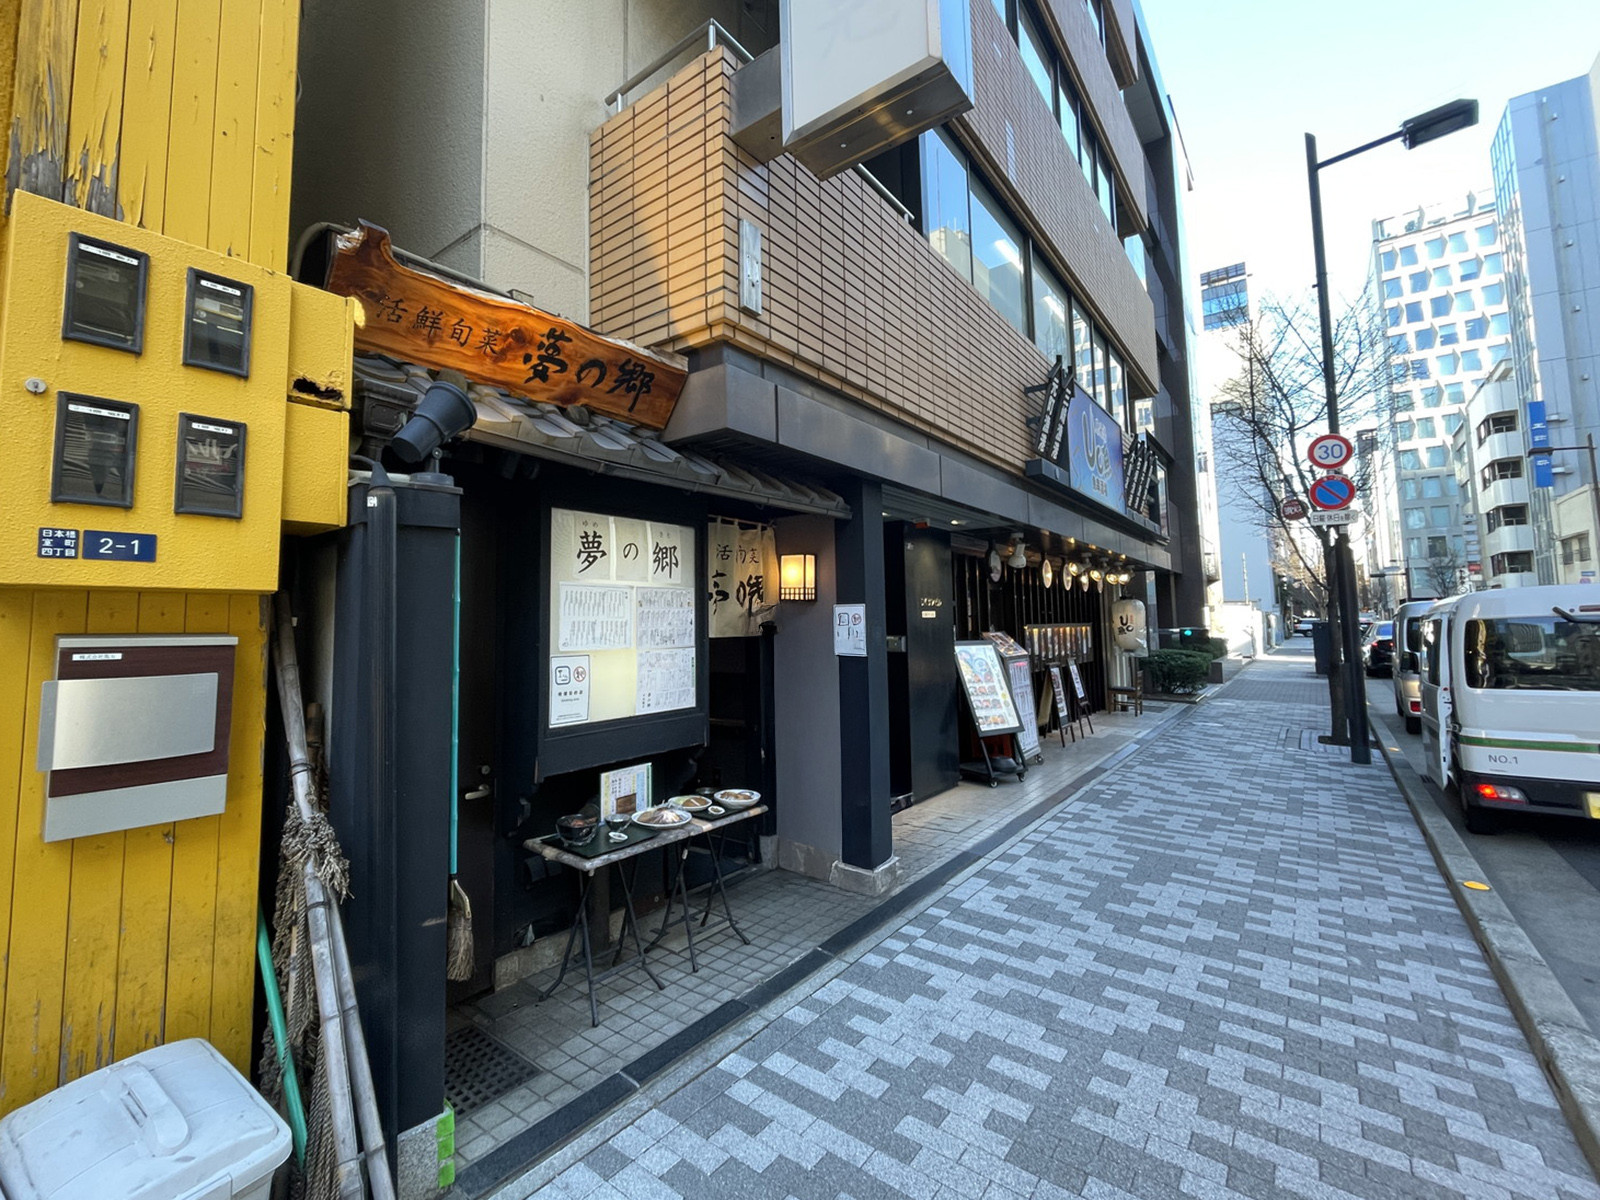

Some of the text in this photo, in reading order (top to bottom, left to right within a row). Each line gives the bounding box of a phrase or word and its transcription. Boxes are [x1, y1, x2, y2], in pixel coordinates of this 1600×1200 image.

[376, 296, 655, 413] 活鮮旬菜 夢の郷
[1318, 444, 1343, 460] 30
[42, 529, 76, 538] 日本橋
[41, 538, 76, 547] 室町
[98, 537, 140, 555] 2-1
[41, 547, 75, 557] 四丁目
[577, 530, 679, 579] 夢の郷
[1488, 754, 1518, 765] NO.1
